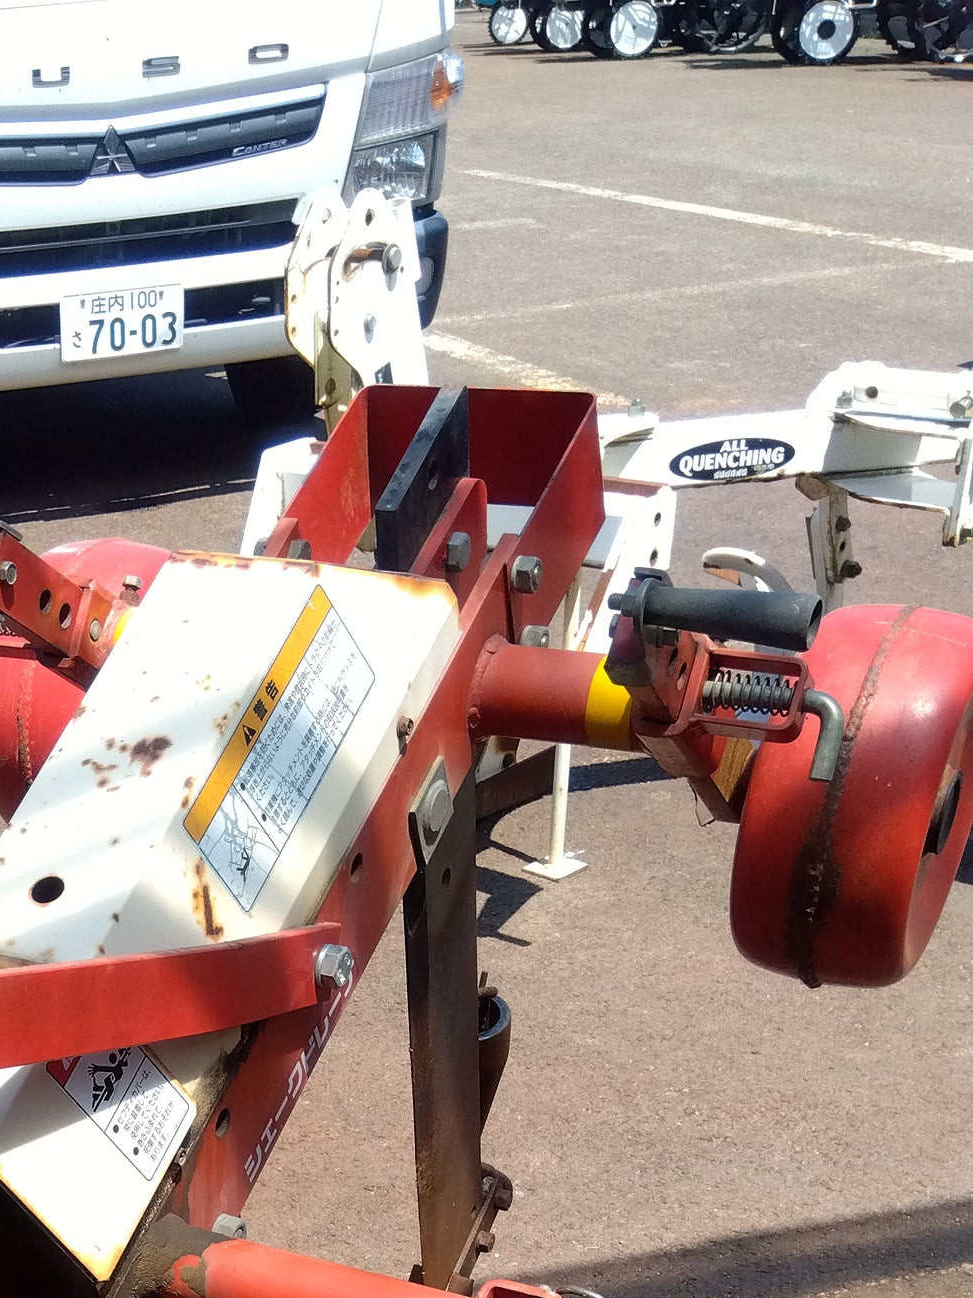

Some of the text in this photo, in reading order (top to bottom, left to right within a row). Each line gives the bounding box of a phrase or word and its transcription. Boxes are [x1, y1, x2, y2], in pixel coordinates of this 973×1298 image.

[232, 139, 288, 157] CANTER
[71, 311, 178, 355] さ 70-03
[678, 446, 786, 477] QUENCHING
[719, 439, 749, 453] ALL
[251, 678, 281, 722] 警告
